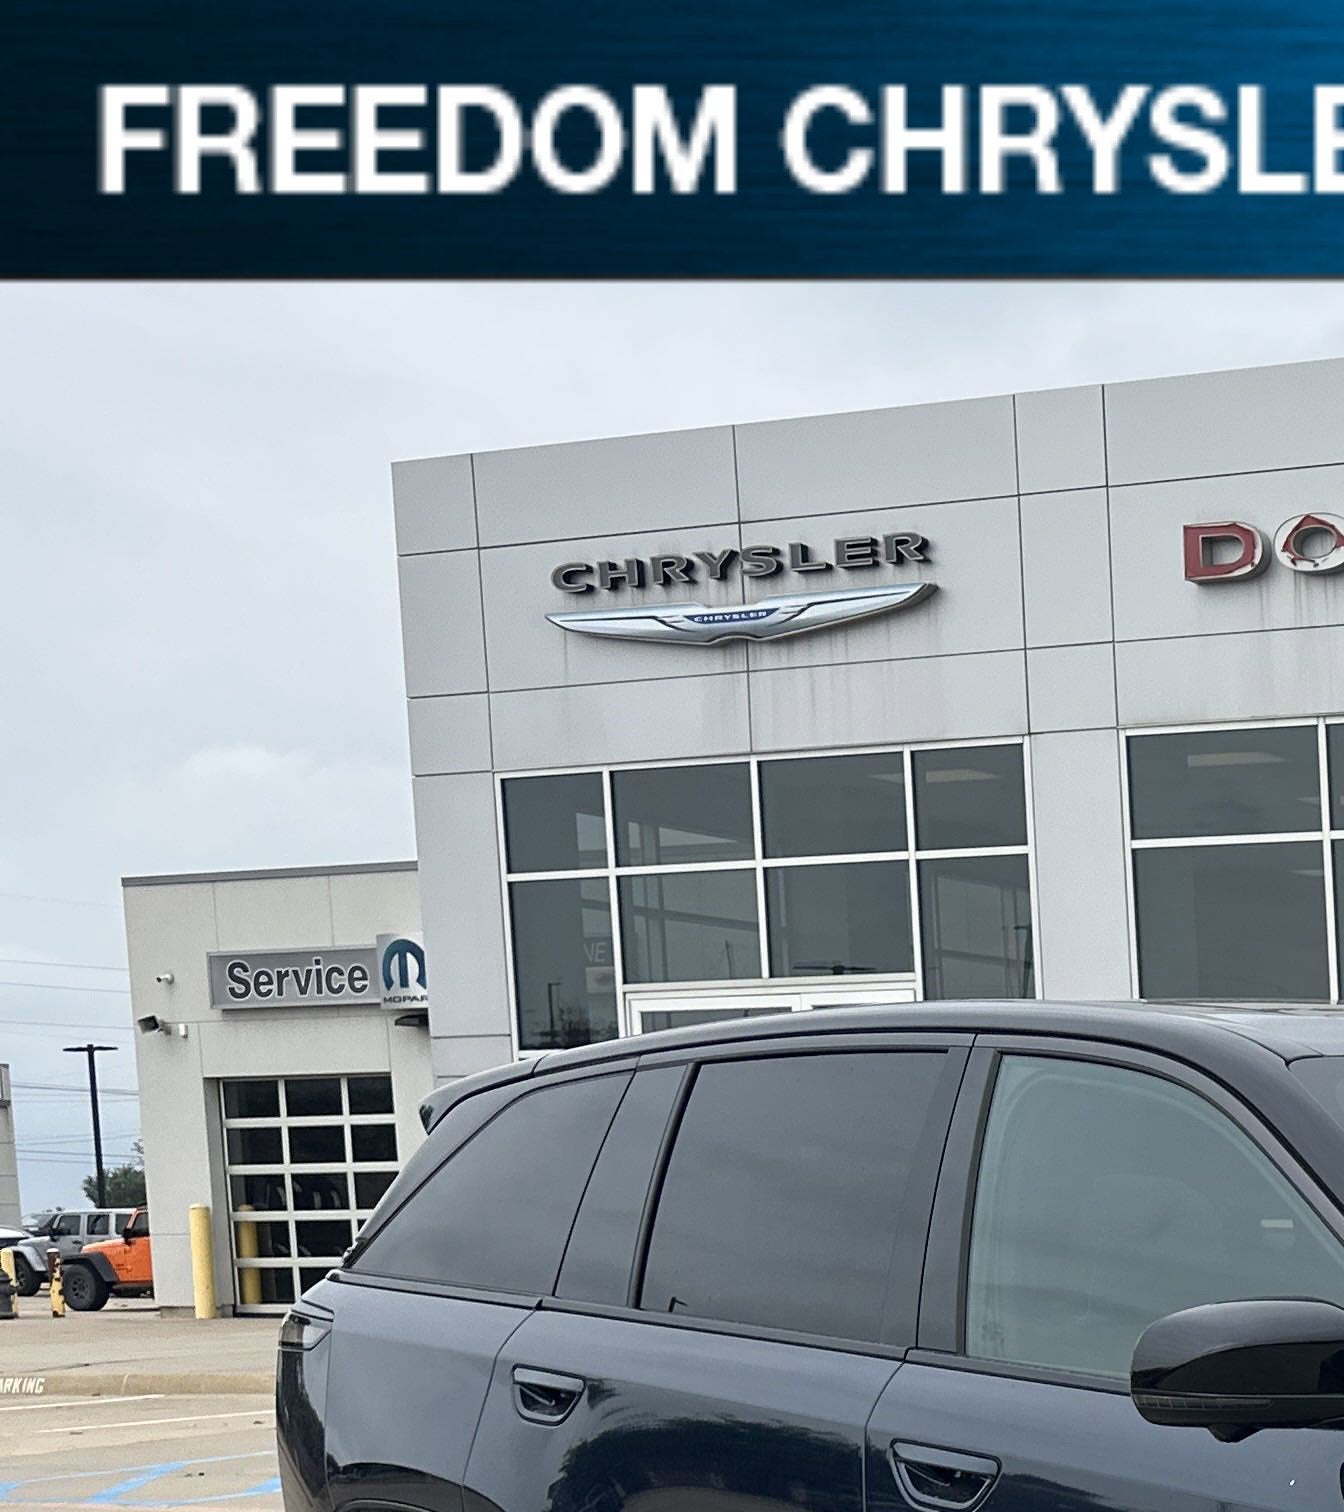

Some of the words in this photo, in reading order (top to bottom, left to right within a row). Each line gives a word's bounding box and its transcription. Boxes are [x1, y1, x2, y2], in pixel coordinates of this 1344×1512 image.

[550, 531, 930, 594] CHRYSLER
[693, 611, 767, 622] CHRYSLER
[227, 957, 370, 1000] Service
